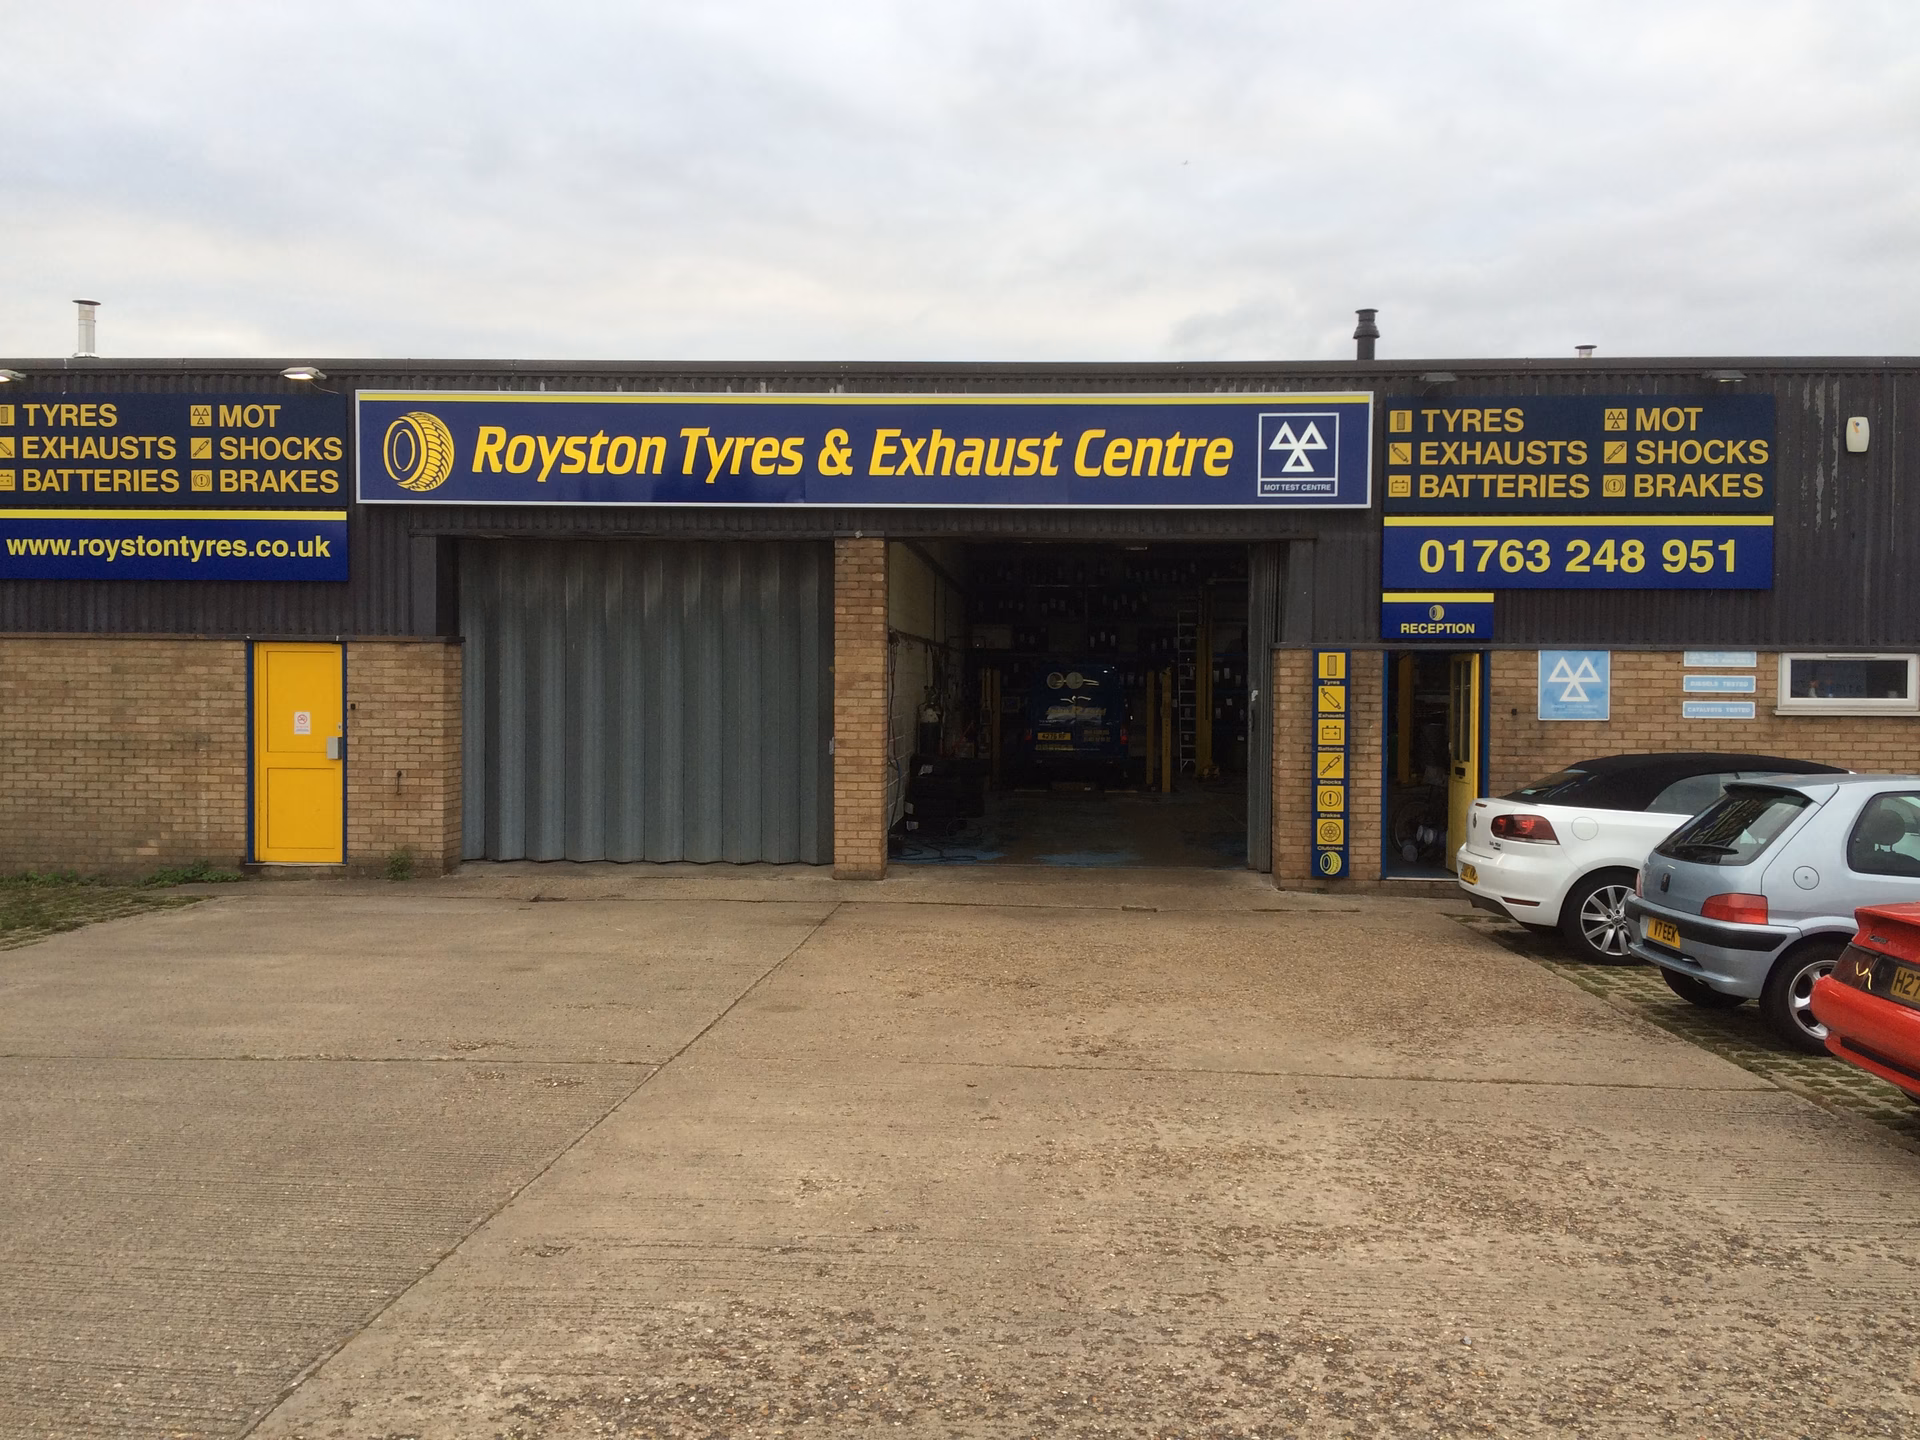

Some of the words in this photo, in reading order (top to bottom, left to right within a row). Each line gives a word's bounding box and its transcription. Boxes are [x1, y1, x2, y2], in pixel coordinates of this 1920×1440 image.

[23, 404, 118, 428] TYRES
[218, 404, 281, 428] MOT
[1421, 408, 1525, 433] TYRES
[1635, 407, 1703, 431] MOT
[22, 436, 177, 461] EXHAUSTS
[219, 436, 343, 461] SHOCKS
[471, 425, 667, 483] Royston
[679, 427, 805, 485] Tyres
[817, 428, 854, 477] &
[868, 428, 1063, 477] Exhaust
[1073, 429, 1235, 478] Centre
[1419, 440, 1588, 466] EXHAUSTS
[1635, 439, 1769, 465] SHOCKS
[22, 468, 180, 493] BATTERIES
[219, 469, 340, 494] BRAKES
[1418, 473, 1591, 499] BATTERIES
[1634, 473, 1764, 498] BRAKES
[6, 535, 331, 563] www.roystontyres.co.uk
[1419, 539, 1551, 574] 01763
[1565, 539, 1646, 574] 248
[1661, 539, 1736, 573] 951
[1400, 623, 1475, 634] RECEPTION
